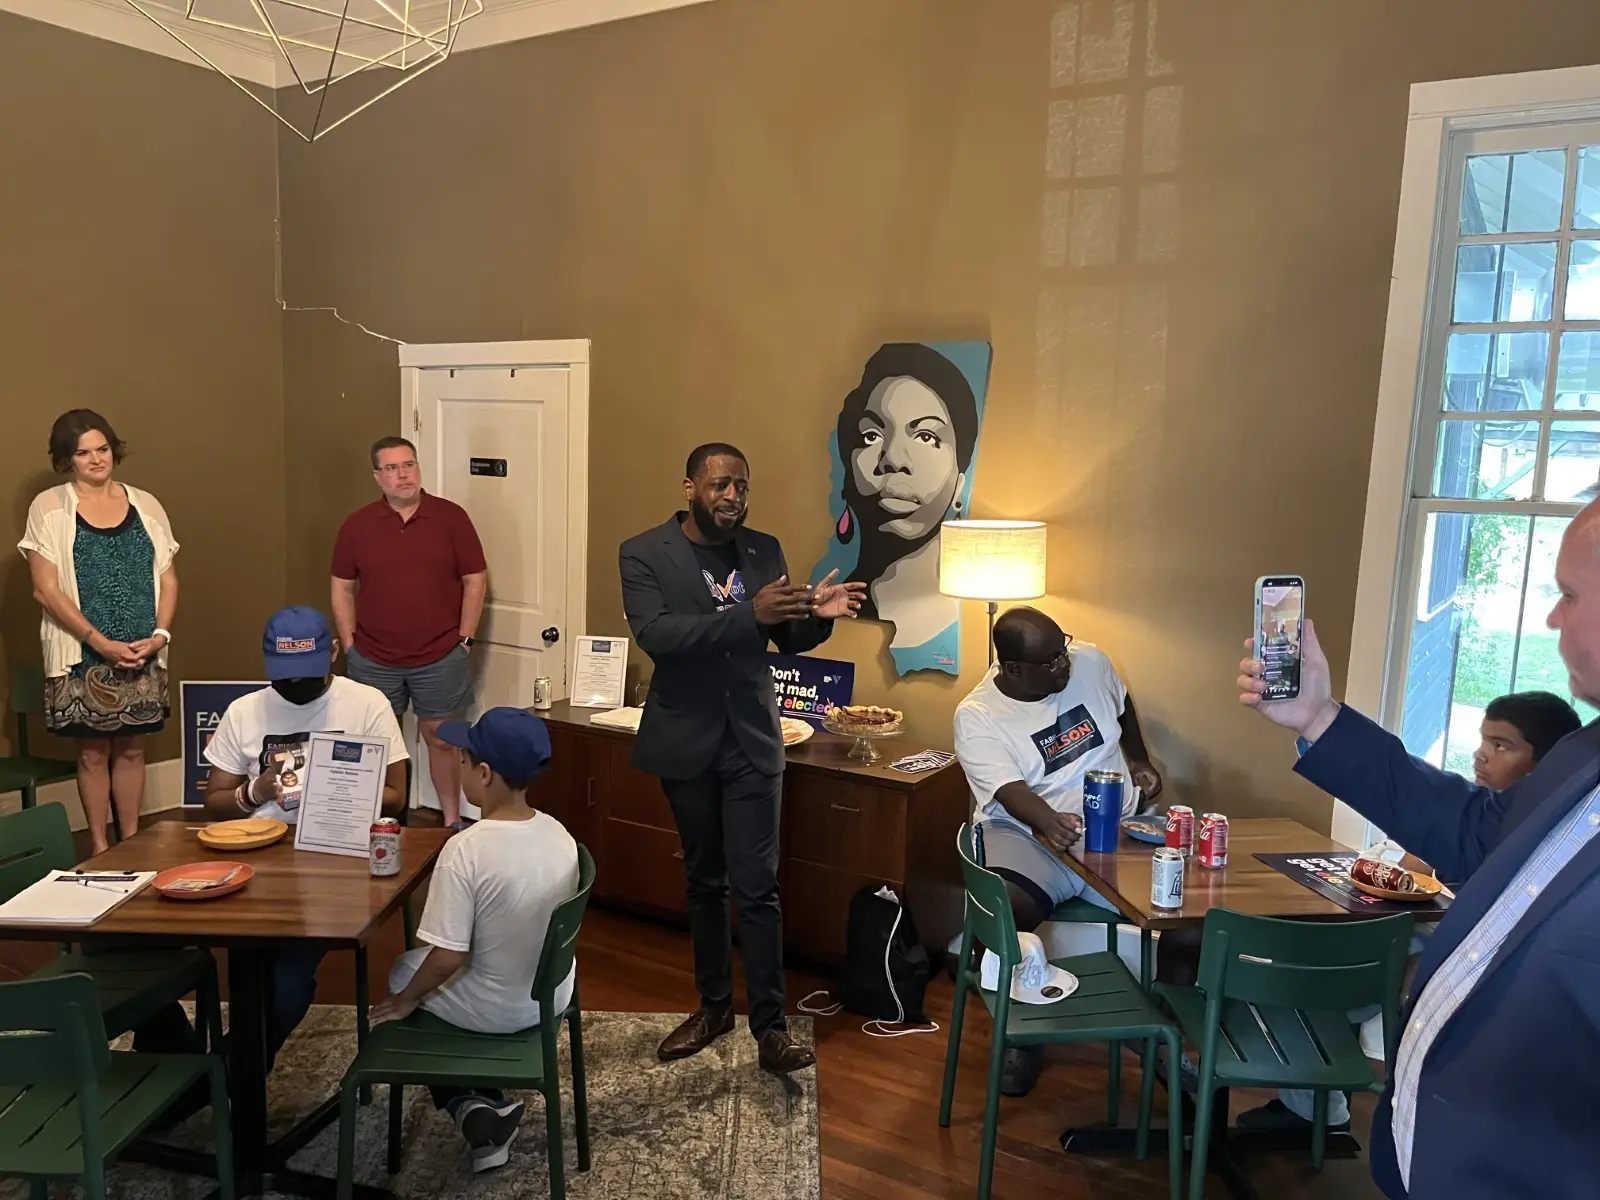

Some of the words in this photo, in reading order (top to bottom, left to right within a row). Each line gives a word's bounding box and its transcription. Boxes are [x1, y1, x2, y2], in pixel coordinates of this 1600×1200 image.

[278, 640, 313, 649] NELSON
[773, 681, 786, 694] et
[786, 685, 819, 701] mad,
